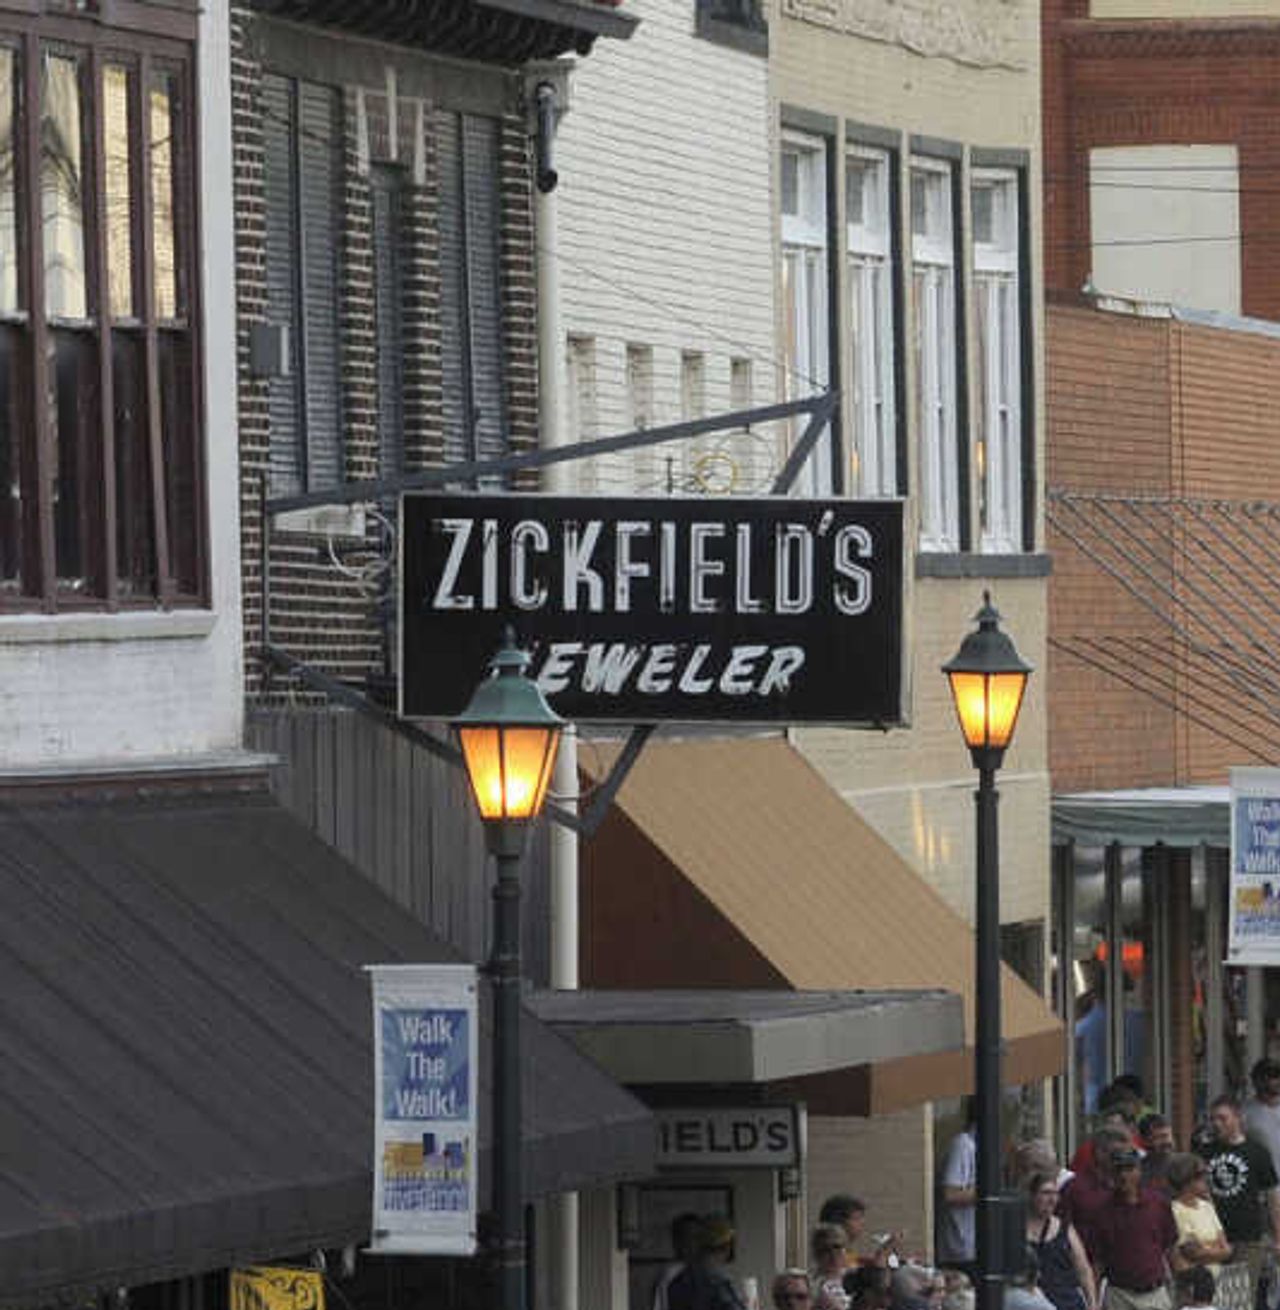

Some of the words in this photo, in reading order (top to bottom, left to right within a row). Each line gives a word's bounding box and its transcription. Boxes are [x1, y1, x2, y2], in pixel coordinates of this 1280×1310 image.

[432, 510, 874, 616] ZICKFIELD'S
[495, 641, 805, 697] EWELER
[400, 1015, 453, 1043] Walk
[407, 1053, 445, 1080] The
[395, 1087, 457, 1118] Walk!
[660, 1120, 789, 1152] IELD'S
